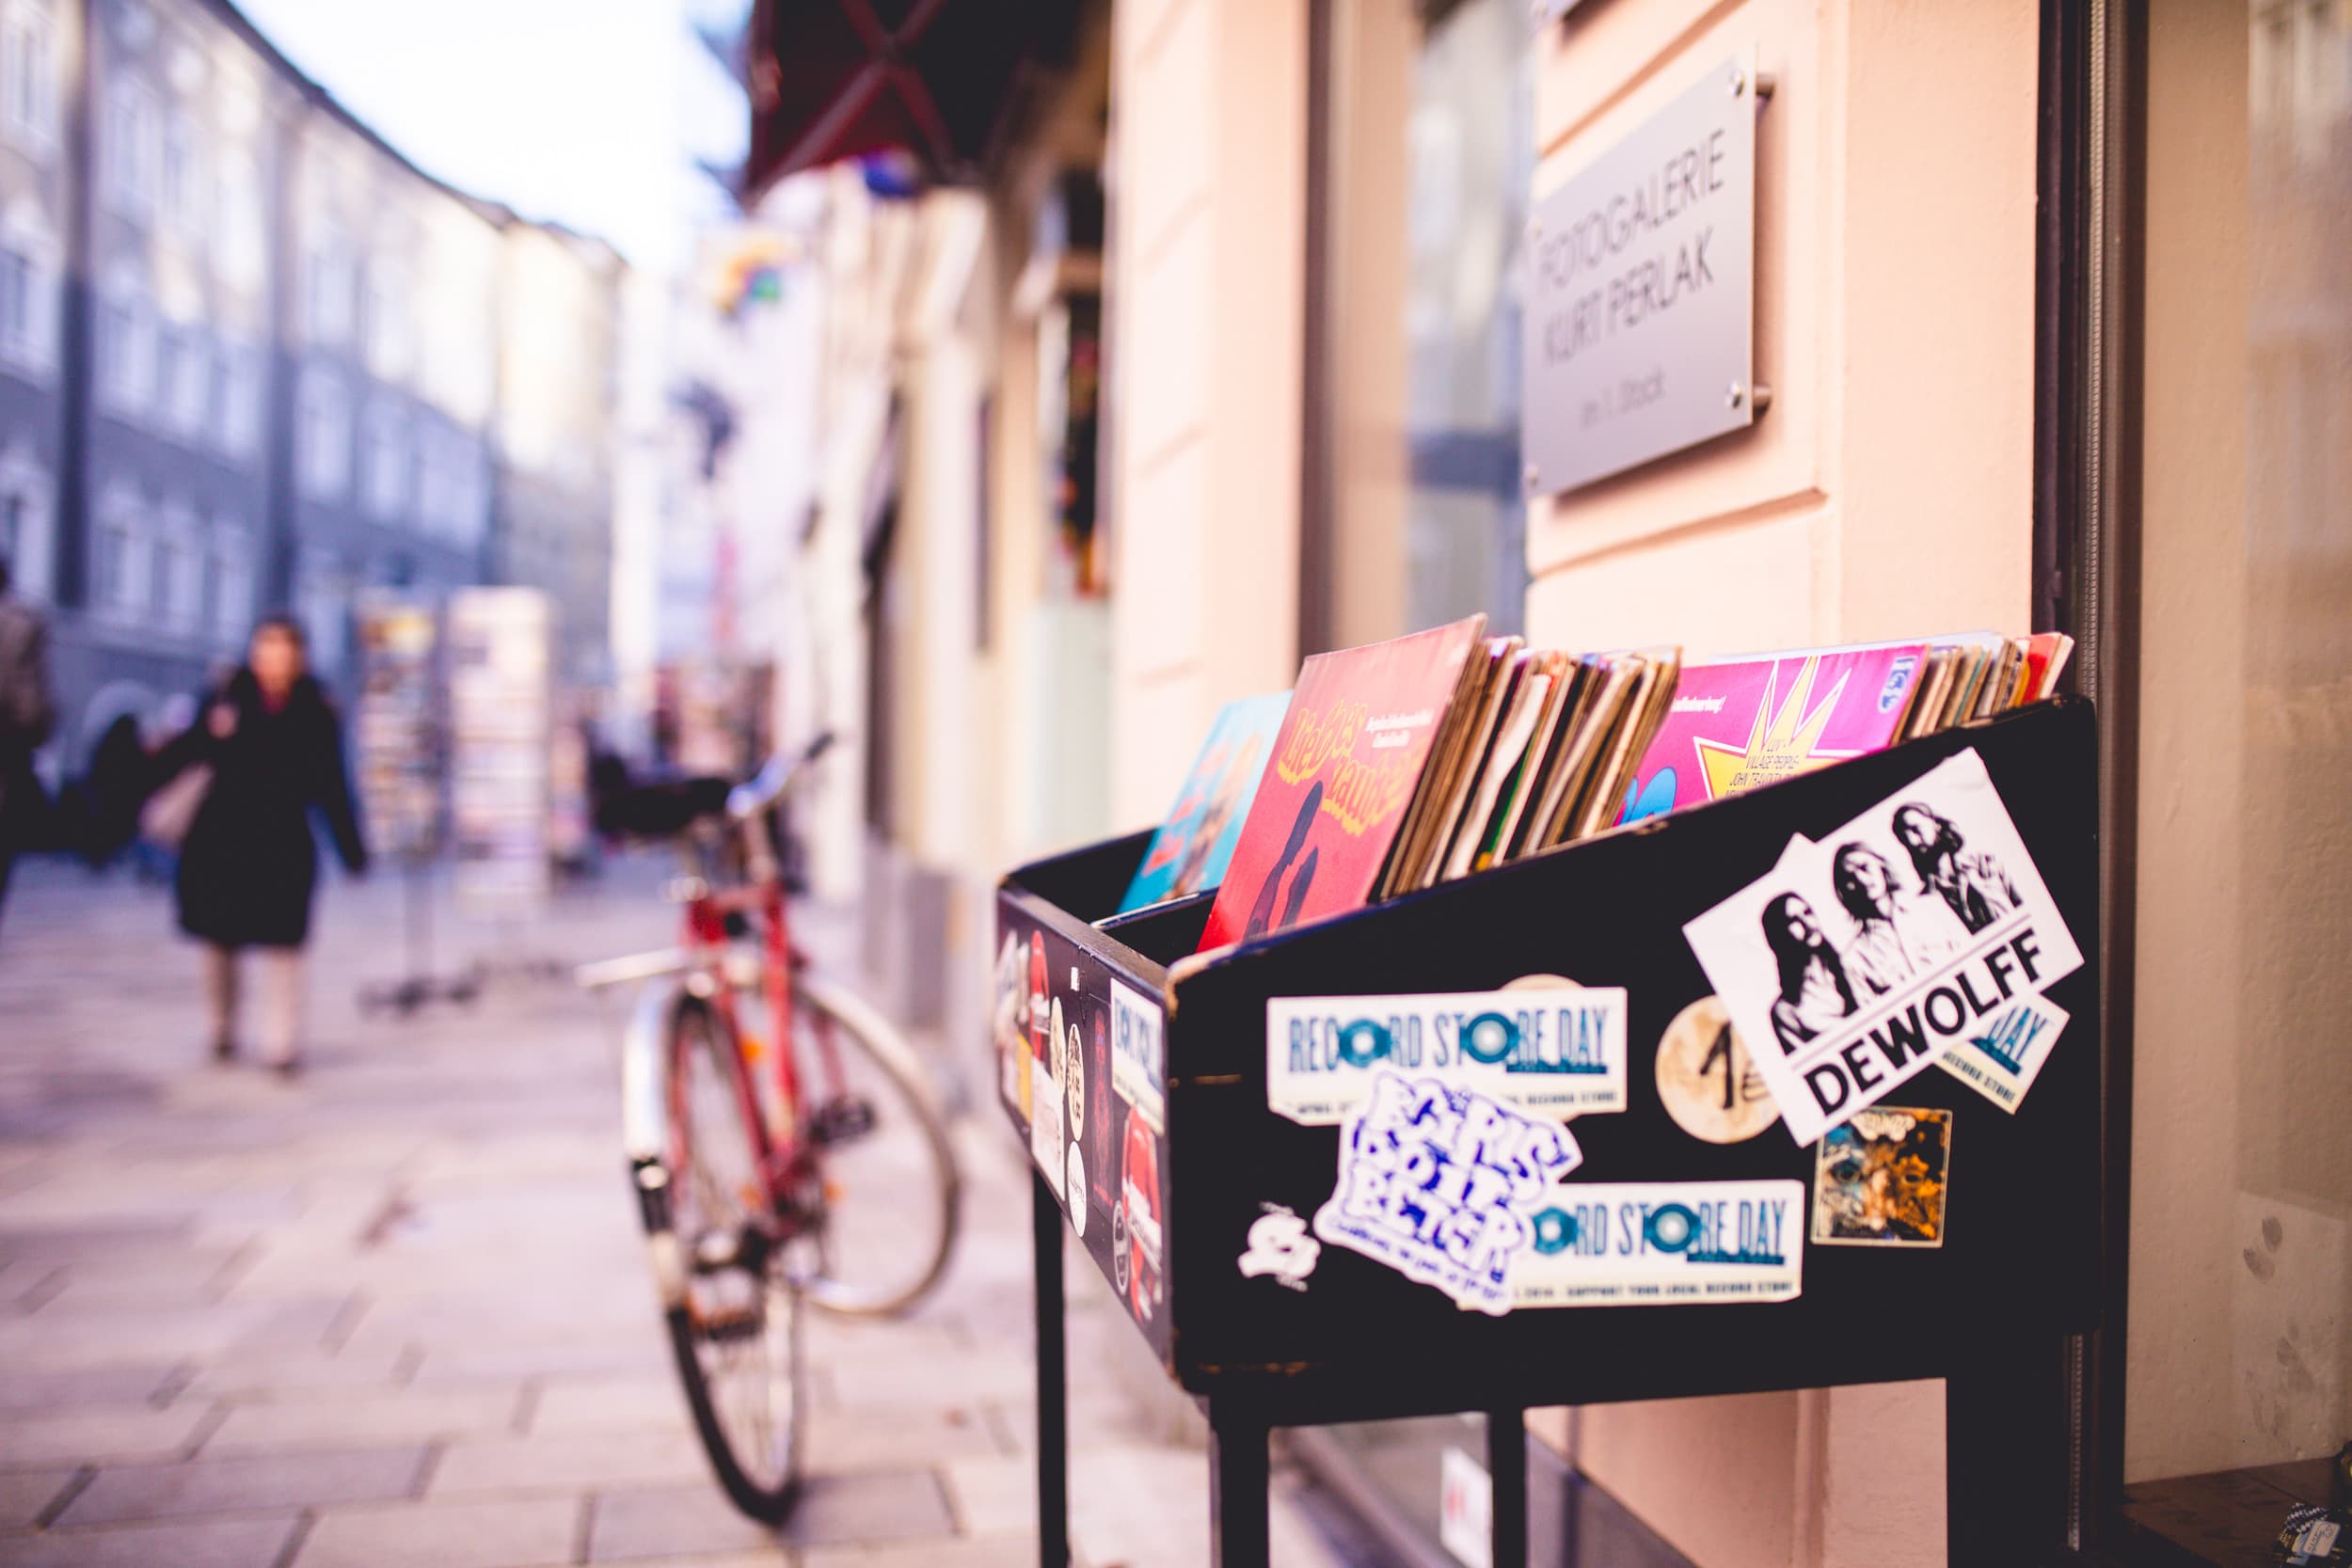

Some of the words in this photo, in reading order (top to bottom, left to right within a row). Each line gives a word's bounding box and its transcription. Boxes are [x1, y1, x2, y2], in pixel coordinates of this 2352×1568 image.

[1540, 128, 1725, 295] FOTOGALERIE
[1543, 287, 1602, 368] KURT
[1608, 226, 1715, 336] PERLAK
[1289, 1015, 1422, 1072] RECORD
[1433, 1009, 1546, 1068] STORE
[1559, 1008, 1609, 1066] DAY
[1804, 928, 2041, 1116] DEWOLFF
[1531, 1204, 1608, 1256] ORD
[1617, 1201, 1727, 1256] STORE
[1739, 1200, 1787, 1256] DAY
